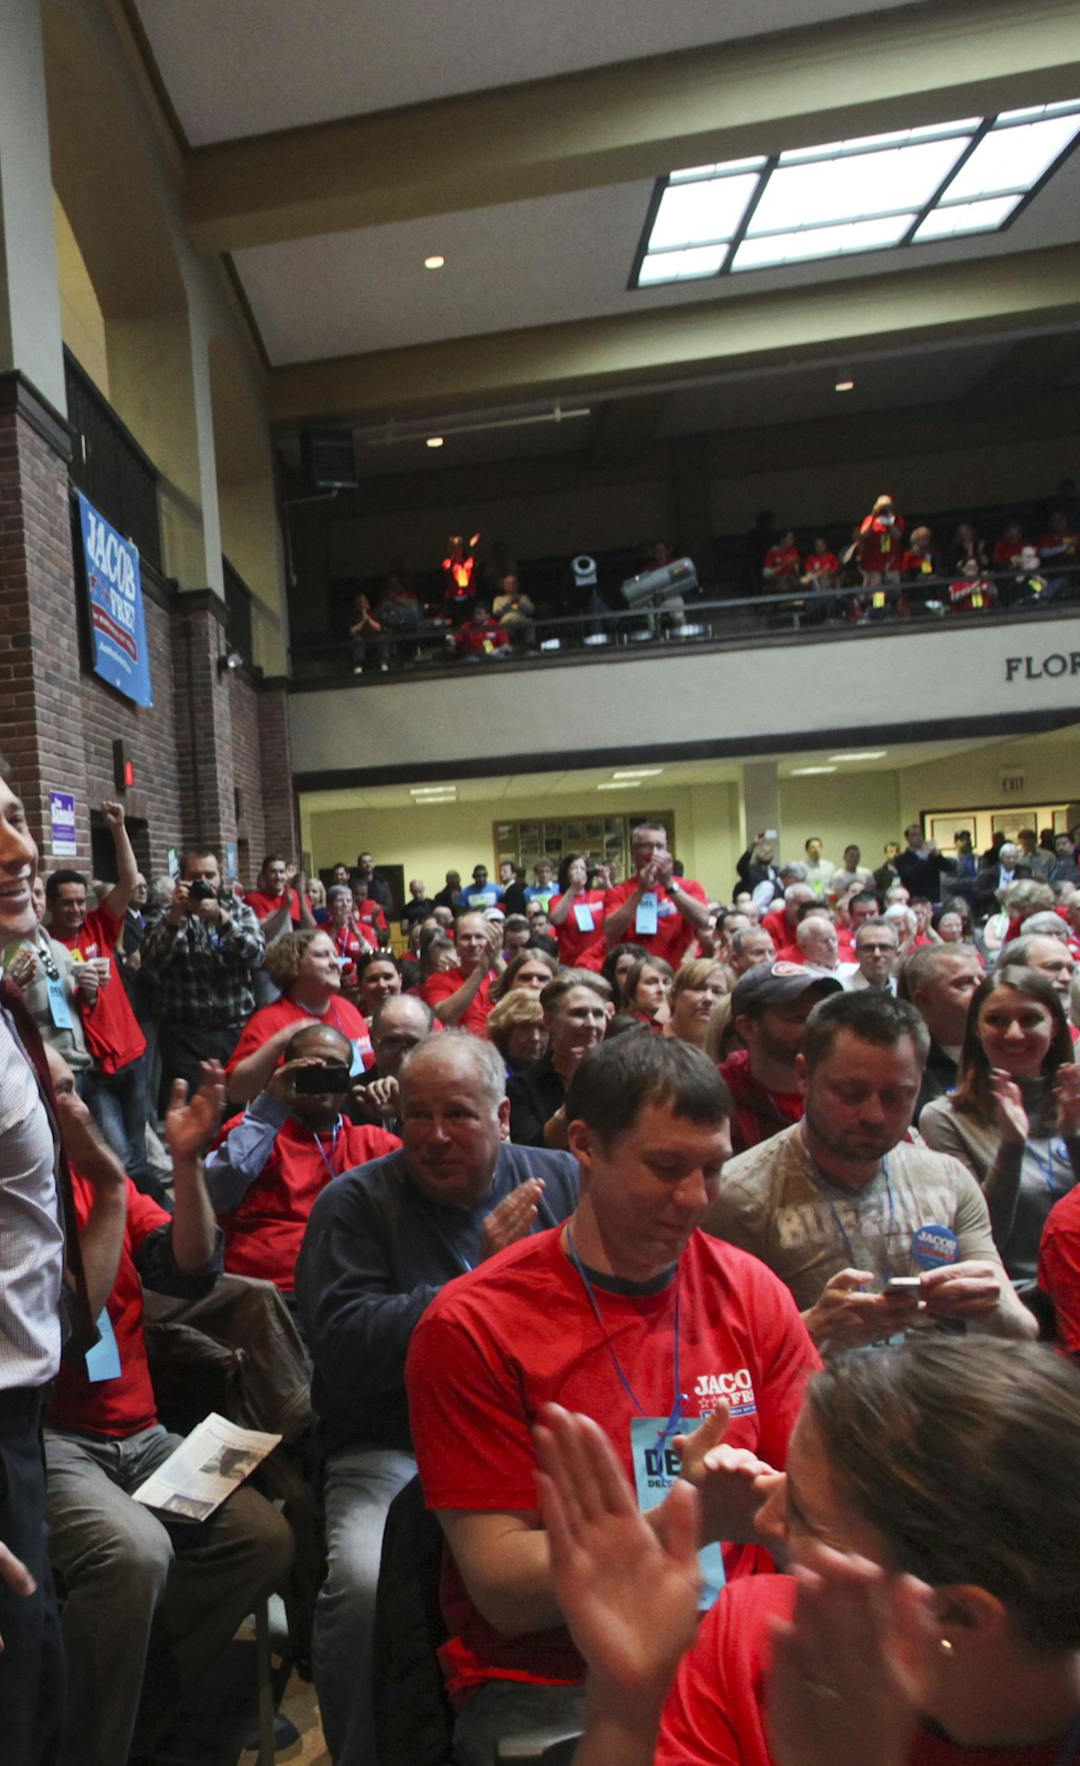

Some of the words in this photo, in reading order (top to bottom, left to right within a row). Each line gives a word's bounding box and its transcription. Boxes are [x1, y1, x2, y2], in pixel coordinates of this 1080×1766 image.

[87, 511, 136, 601] JACOB
[1002, 775, 1024, 792] EXIT
[917, 1231, 957, 1249] JACOB
[694, 1368, 752, 1396] JACO
